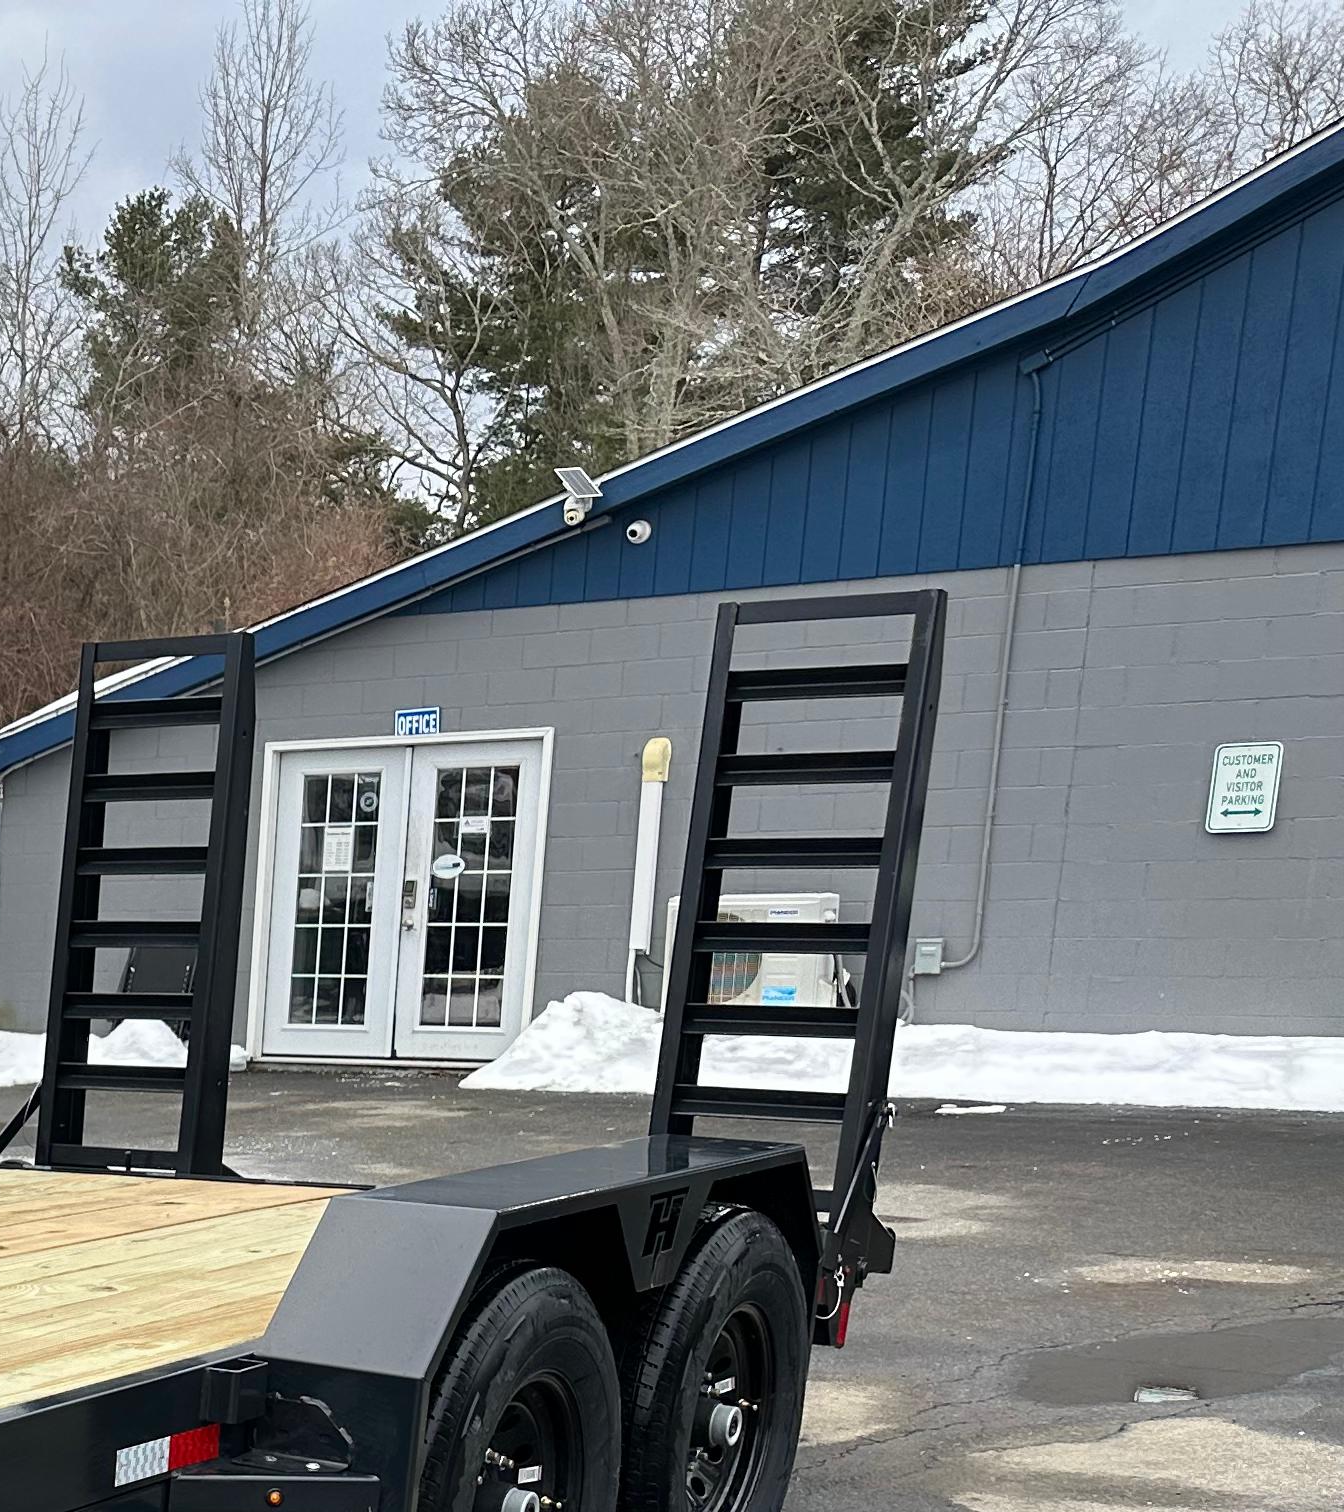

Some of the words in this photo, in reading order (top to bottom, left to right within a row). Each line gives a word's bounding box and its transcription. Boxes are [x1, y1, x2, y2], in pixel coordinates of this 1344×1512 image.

[398, 713, 437, 735] OFFICE
[1222, 753, 1274, 766] CUSTOMER
[1235, 768, 1257, 779] AND
[1226, 780, 1263, 792] VISITOR
[1221, 794, 1265, 806] PARKING
